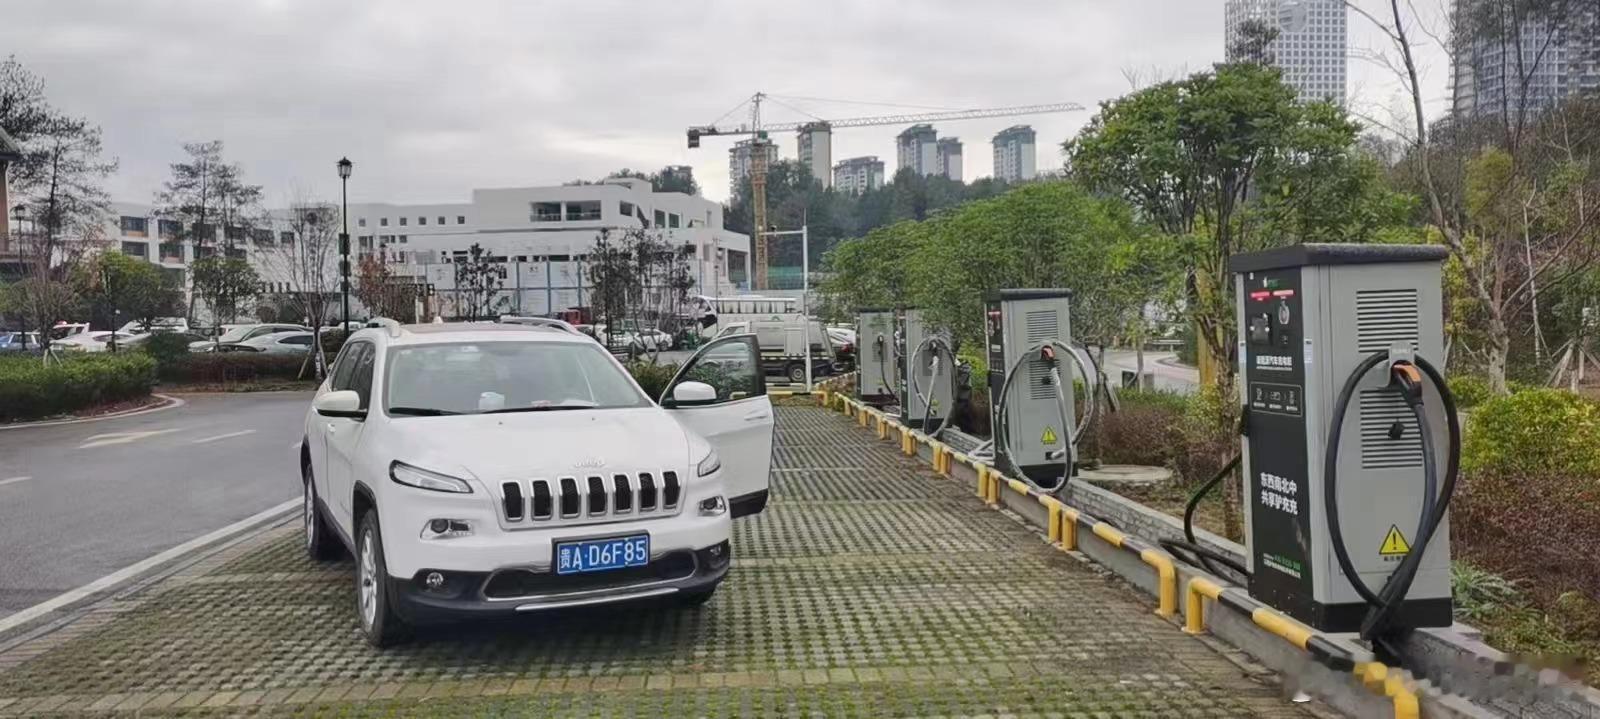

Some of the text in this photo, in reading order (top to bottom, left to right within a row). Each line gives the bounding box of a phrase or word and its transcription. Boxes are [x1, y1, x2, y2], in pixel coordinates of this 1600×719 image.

[1260, 471, 1297, 496] 东西南北中
[1261, 489, 1298, 515] 共享驴充充
